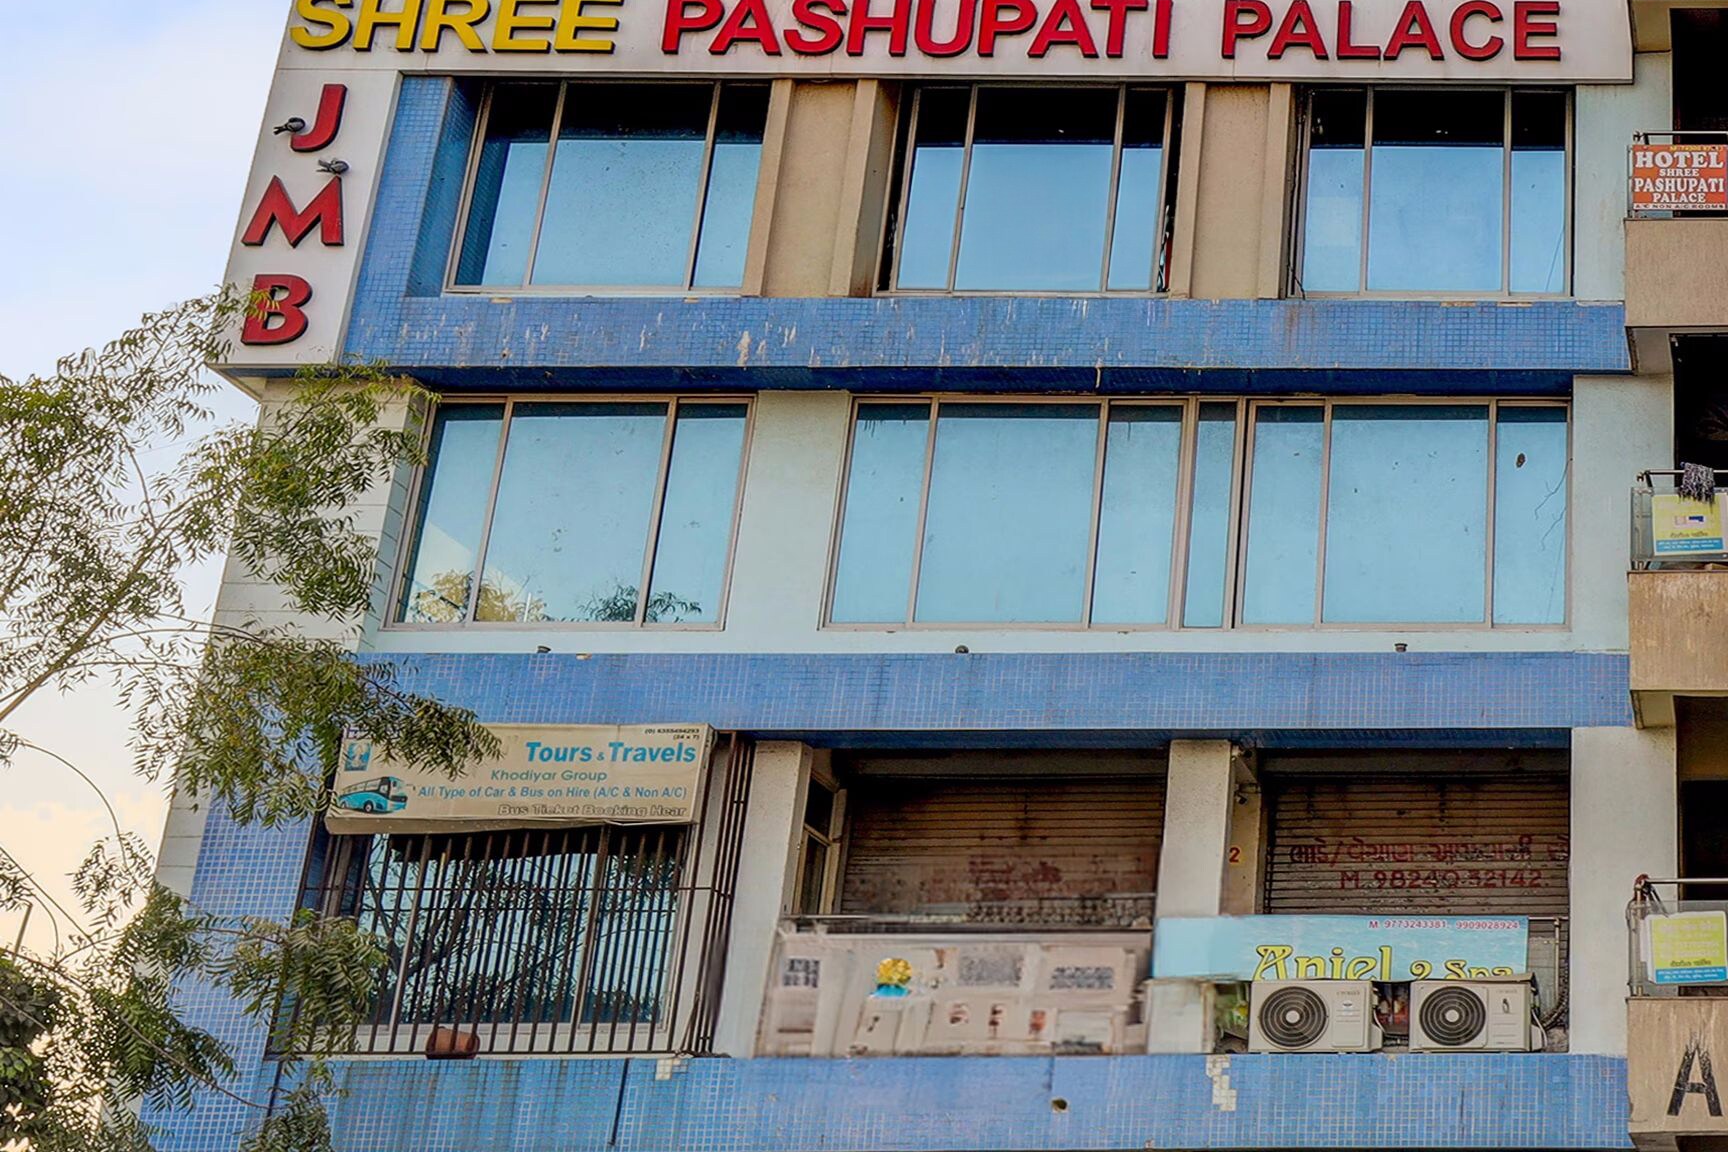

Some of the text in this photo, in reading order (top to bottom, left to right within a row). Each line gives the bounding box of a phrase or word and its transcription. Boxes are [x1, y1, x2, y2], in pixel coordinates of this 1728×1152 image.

[1635, 151, 1724, 168] HOTEL
[1659, 169, 1700, 177] SHREE
[1634, 178, 1725, 192] PASHUPATI
[1653, 193, 1706, 203] PALACE
[526, 741, 696, 762] Tours & Travels
[491, 770, 607, 782] Khodiyar Group
[418, 786, 687, 799] All Type of Car & Bus on Hire (A/C & Non A/C)
[498, 804, 528, 815] Bus
[581, 804, 648, 817] Booking
[651, 805, 687, 816] Hear
[1228, 847, 1241, 863] 2
[1667, 1042, 1723, 1117] A
